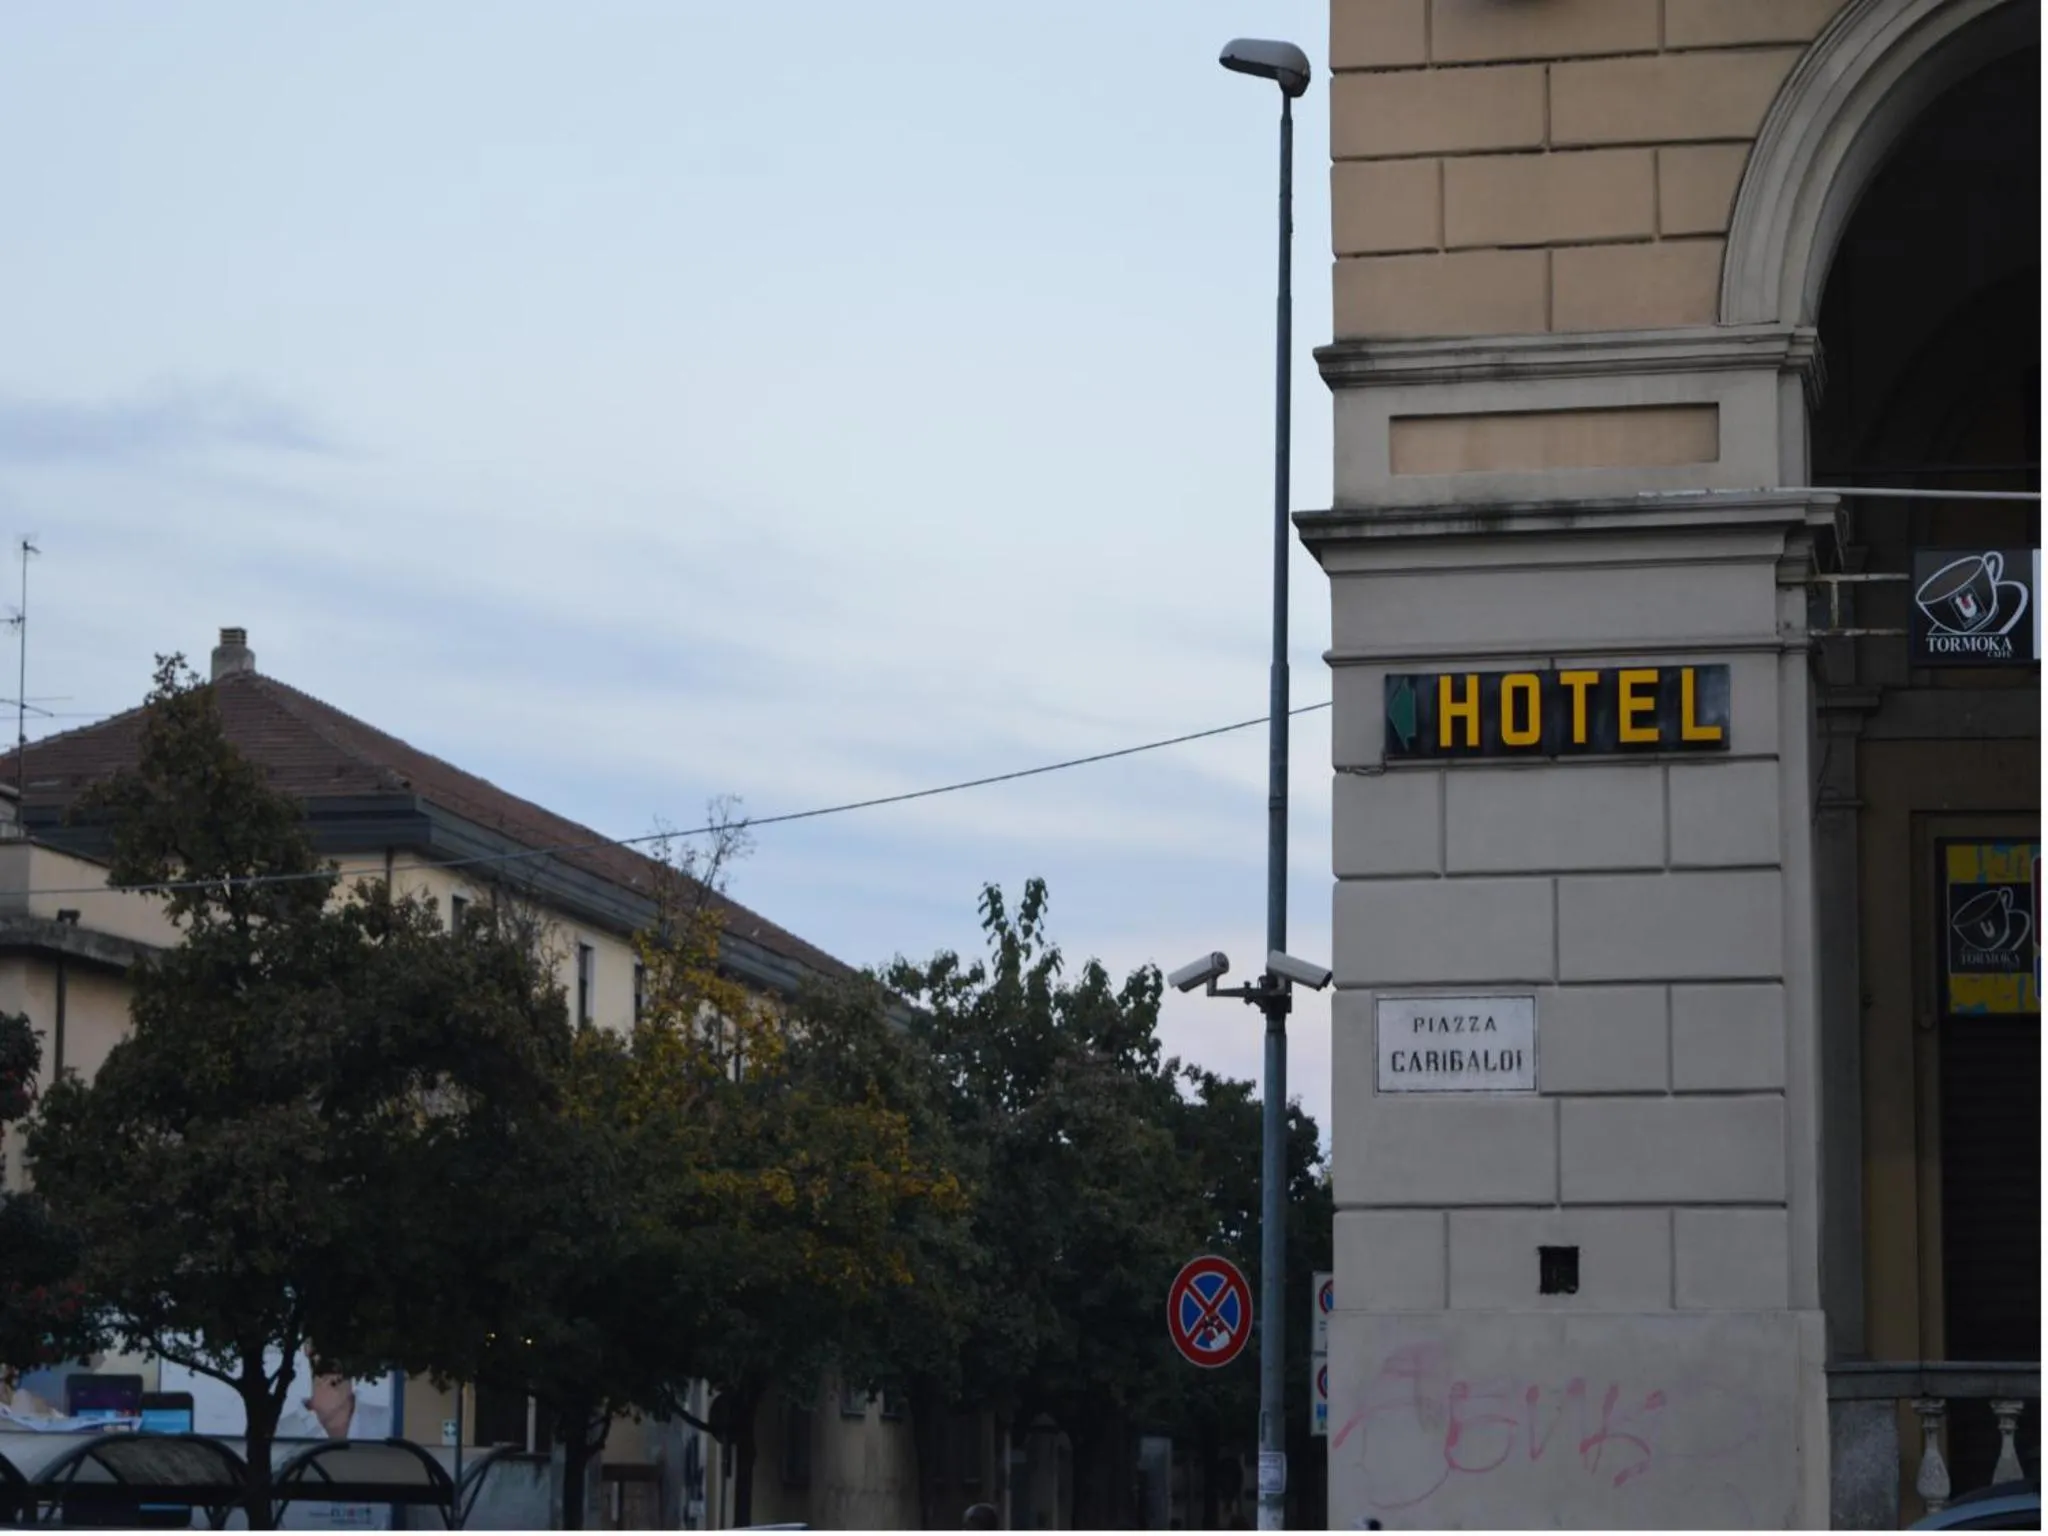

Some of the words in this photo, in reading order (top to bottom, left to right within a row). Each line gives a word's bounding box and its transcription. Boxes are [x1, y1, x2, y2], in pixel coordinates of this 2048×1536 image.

[1926, 636, 2013, 653] TORMOKA
[1438, 667, 1723, 748] HOTEL
[1412, 1015, 1498, 1034] PIAZZA
[1391, 1049, 1522, 1073] GARIBALDI
